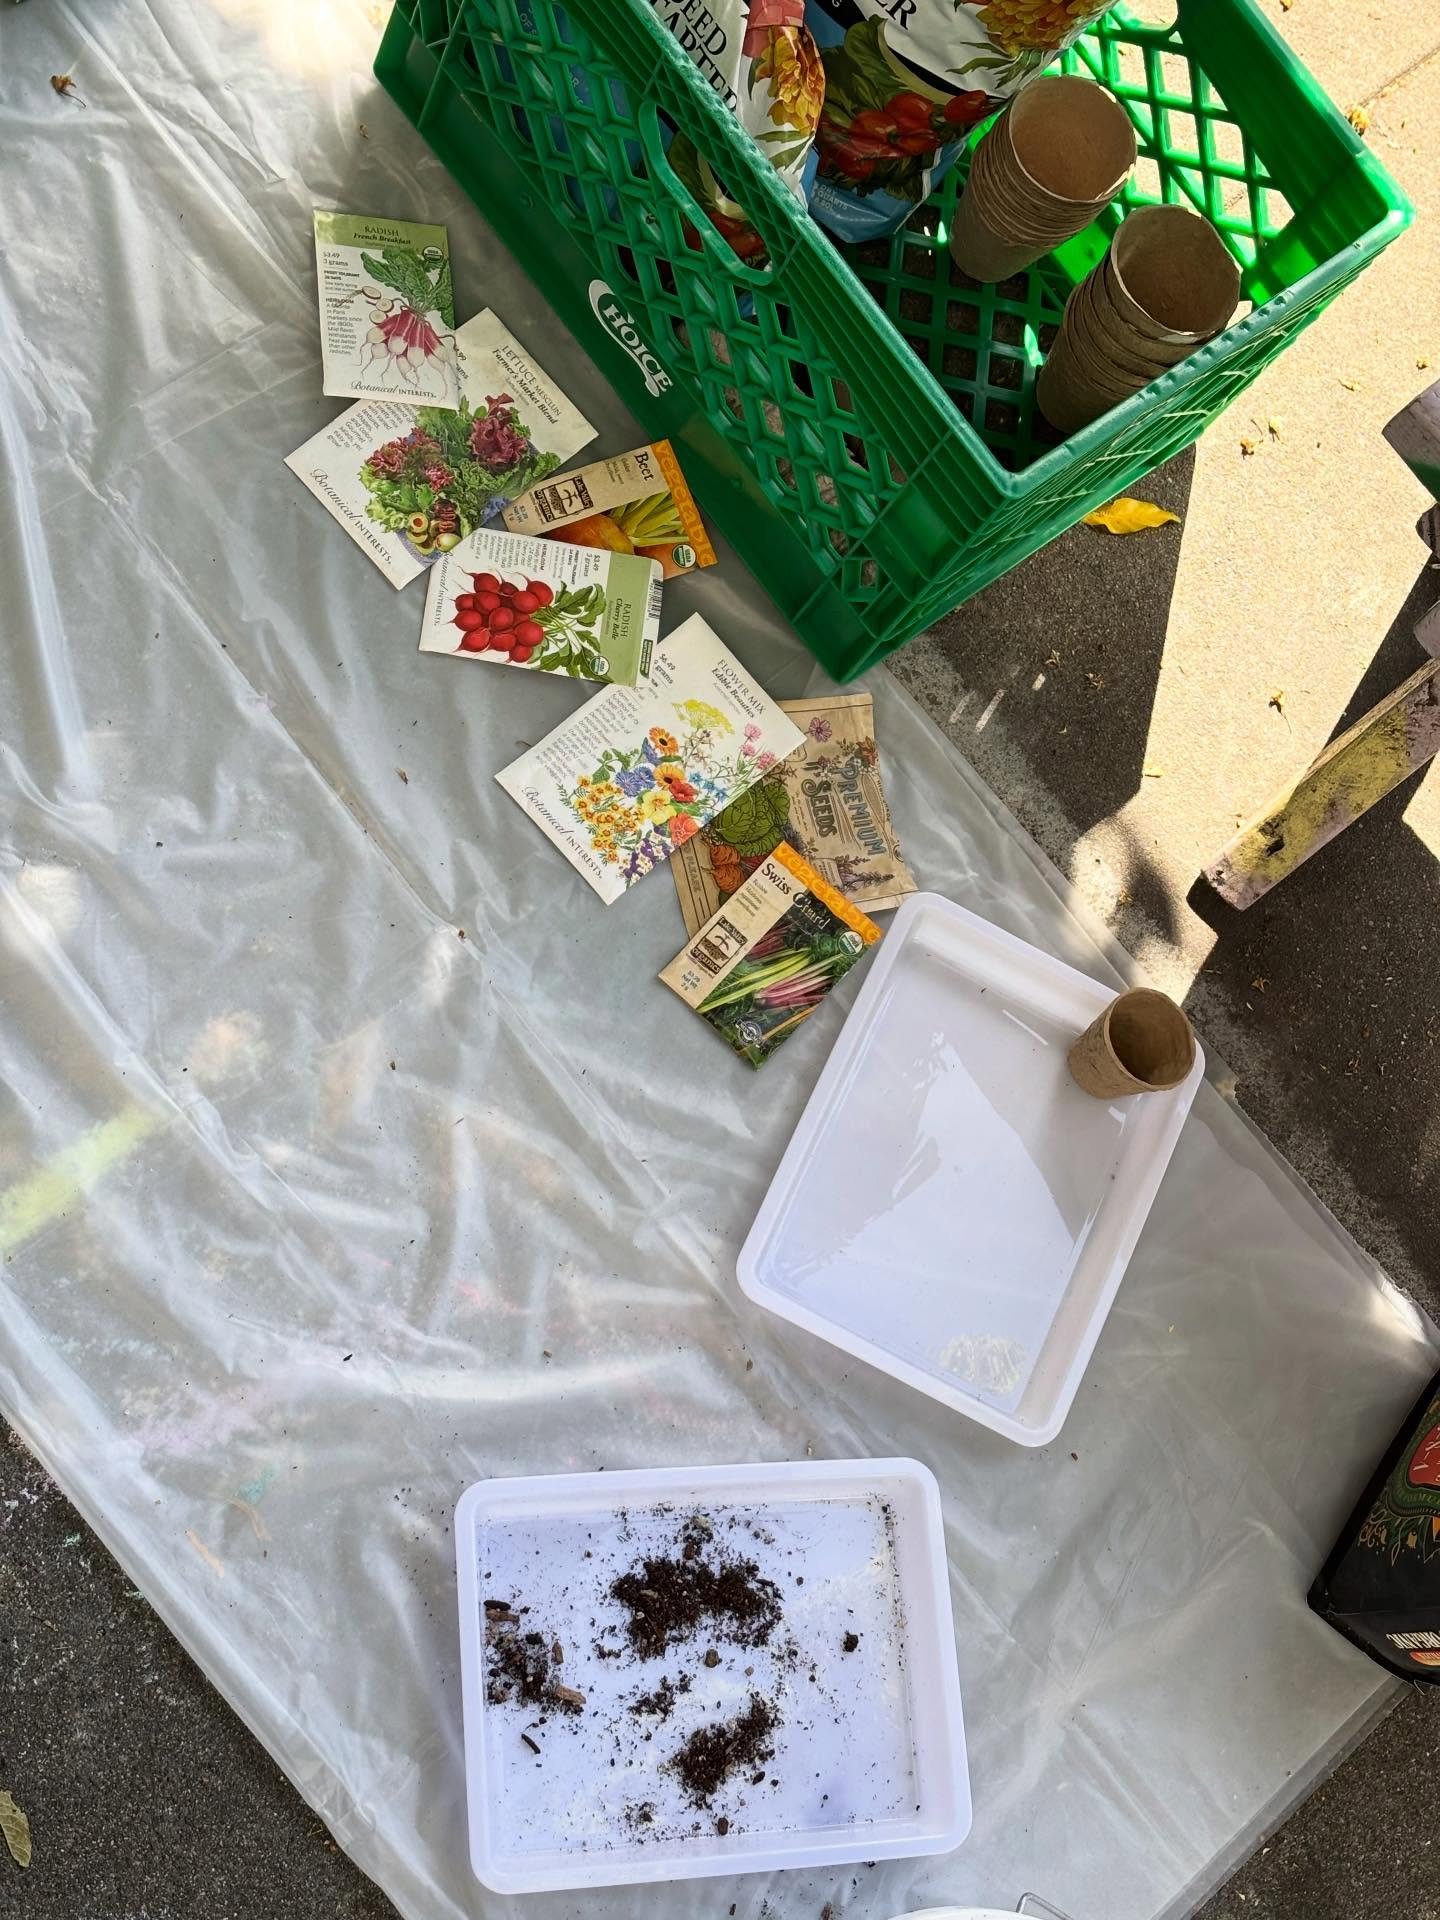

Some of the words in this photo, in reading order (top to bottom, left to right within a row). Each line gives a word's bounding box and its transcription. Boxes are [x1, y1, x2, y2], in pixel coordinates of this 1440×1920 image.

[674, 0, 727, 56] EED
[364, 225, 399, 236] RADISH
[350, 378, 398, 394] Botanical
[491, 349, 519, 378] Farmer's
[516, 378, 540, 403] Market
[538, 403, 558, 424] Blend
[501, 345, 536, 384] LETTUCE
[533, 385, 561, 416] MESCLUN
[633, 450, 655, 482] Beet
[310, 467, 357, 522] Botanical
[610, 623, 620, 640] Belle
[612, 597, 623, 622] Cherry
[618, 602, 632, 637] RADISH
[655, 664, 673, 684] grams
[711, 667, 732, 689] Edible
[729, 688, 757, 717] Beauties
[717, 659, 750, 695] FLOWER
[747, 694, 766, 713] MIX
[521, 784, 568, 838] Botanical
[801, 778, 837, 839] SEEDS
[831, 758, 887, 856] PREMIUM
[761, 863, 793, 894] Swiss
[791, 891, 829, 929] Chard
[718, 918, 732, 932] Lake
[729, 929, 745, 945] Valley
[691, 947, 719, 974] organics
